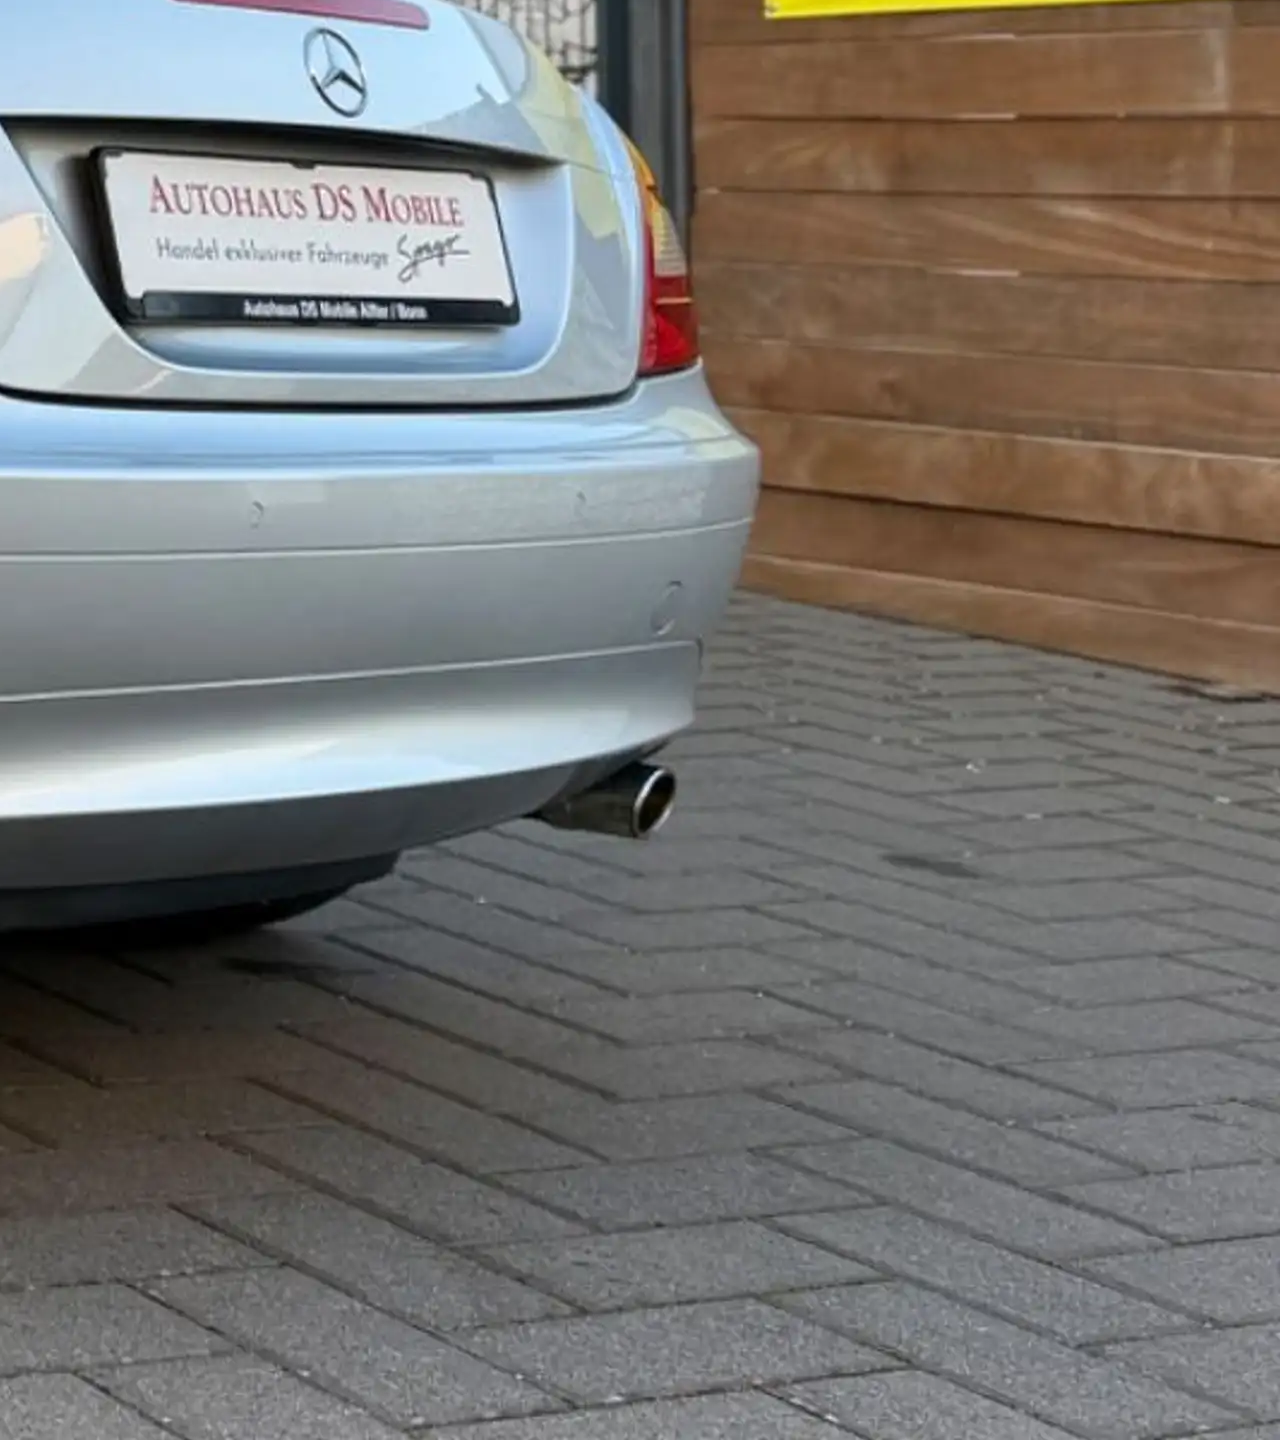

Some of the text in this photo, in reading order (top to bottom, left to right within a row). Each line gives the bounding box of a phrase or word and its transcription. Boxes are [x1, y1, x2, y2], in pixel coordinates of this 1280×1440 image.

[148, 174, 465, 227] AUTOHAUS DS MOBILE
[156, 236, 219, 261] Handel
[306, 241, 389, 270] Fahrzeuge
